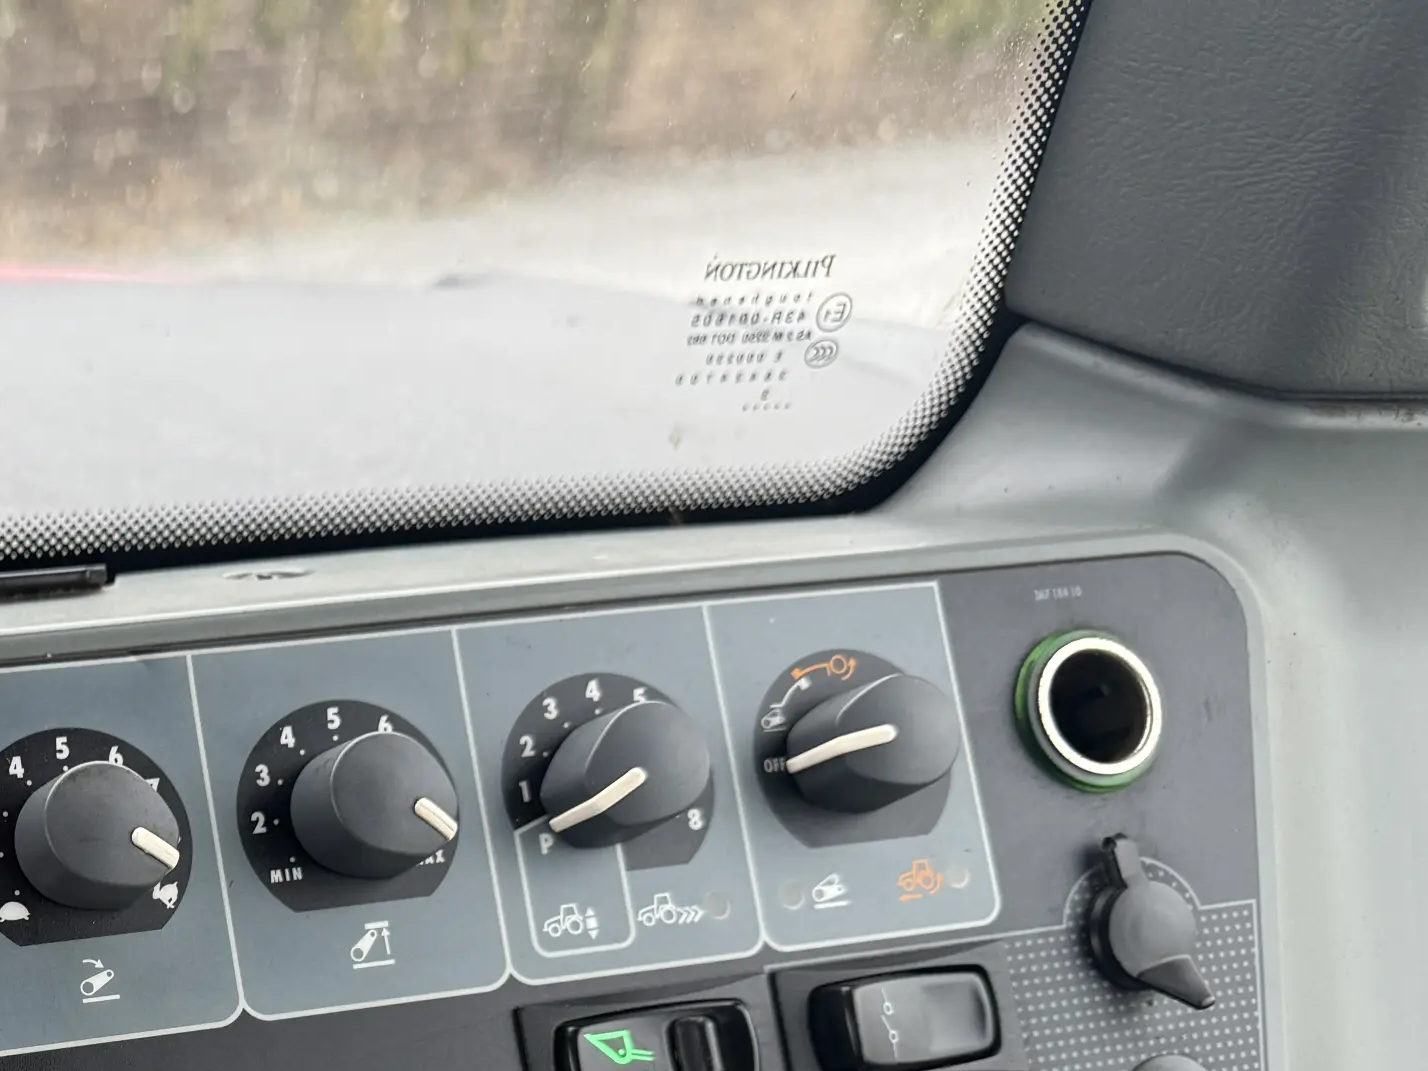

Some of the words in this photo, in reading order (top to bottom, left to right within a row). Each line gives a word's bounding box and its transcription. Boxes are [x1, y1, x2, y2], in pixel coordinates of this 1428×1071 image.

[585, 679, 601, 701] 4
[327, 707, 341, 730] 5
[542, 698, 558, 719] 3
[378, 715, 393, 733] 6
[55, 736, 69, 759] 5
[280, 726, 295, 748] 4
[519, 735, 535, 757] 2
[9, 756, 24, 778] 4
[109, 746, 123, 766] 6
[255, 764, 270, 786] 3
[519, 781, 529, 802] 1
[251, 811, 267, 834] 2
[687, 809, 703, 830] 8
[539, 834, 553, 854] P
[270, 867, 302, 884] MIN
